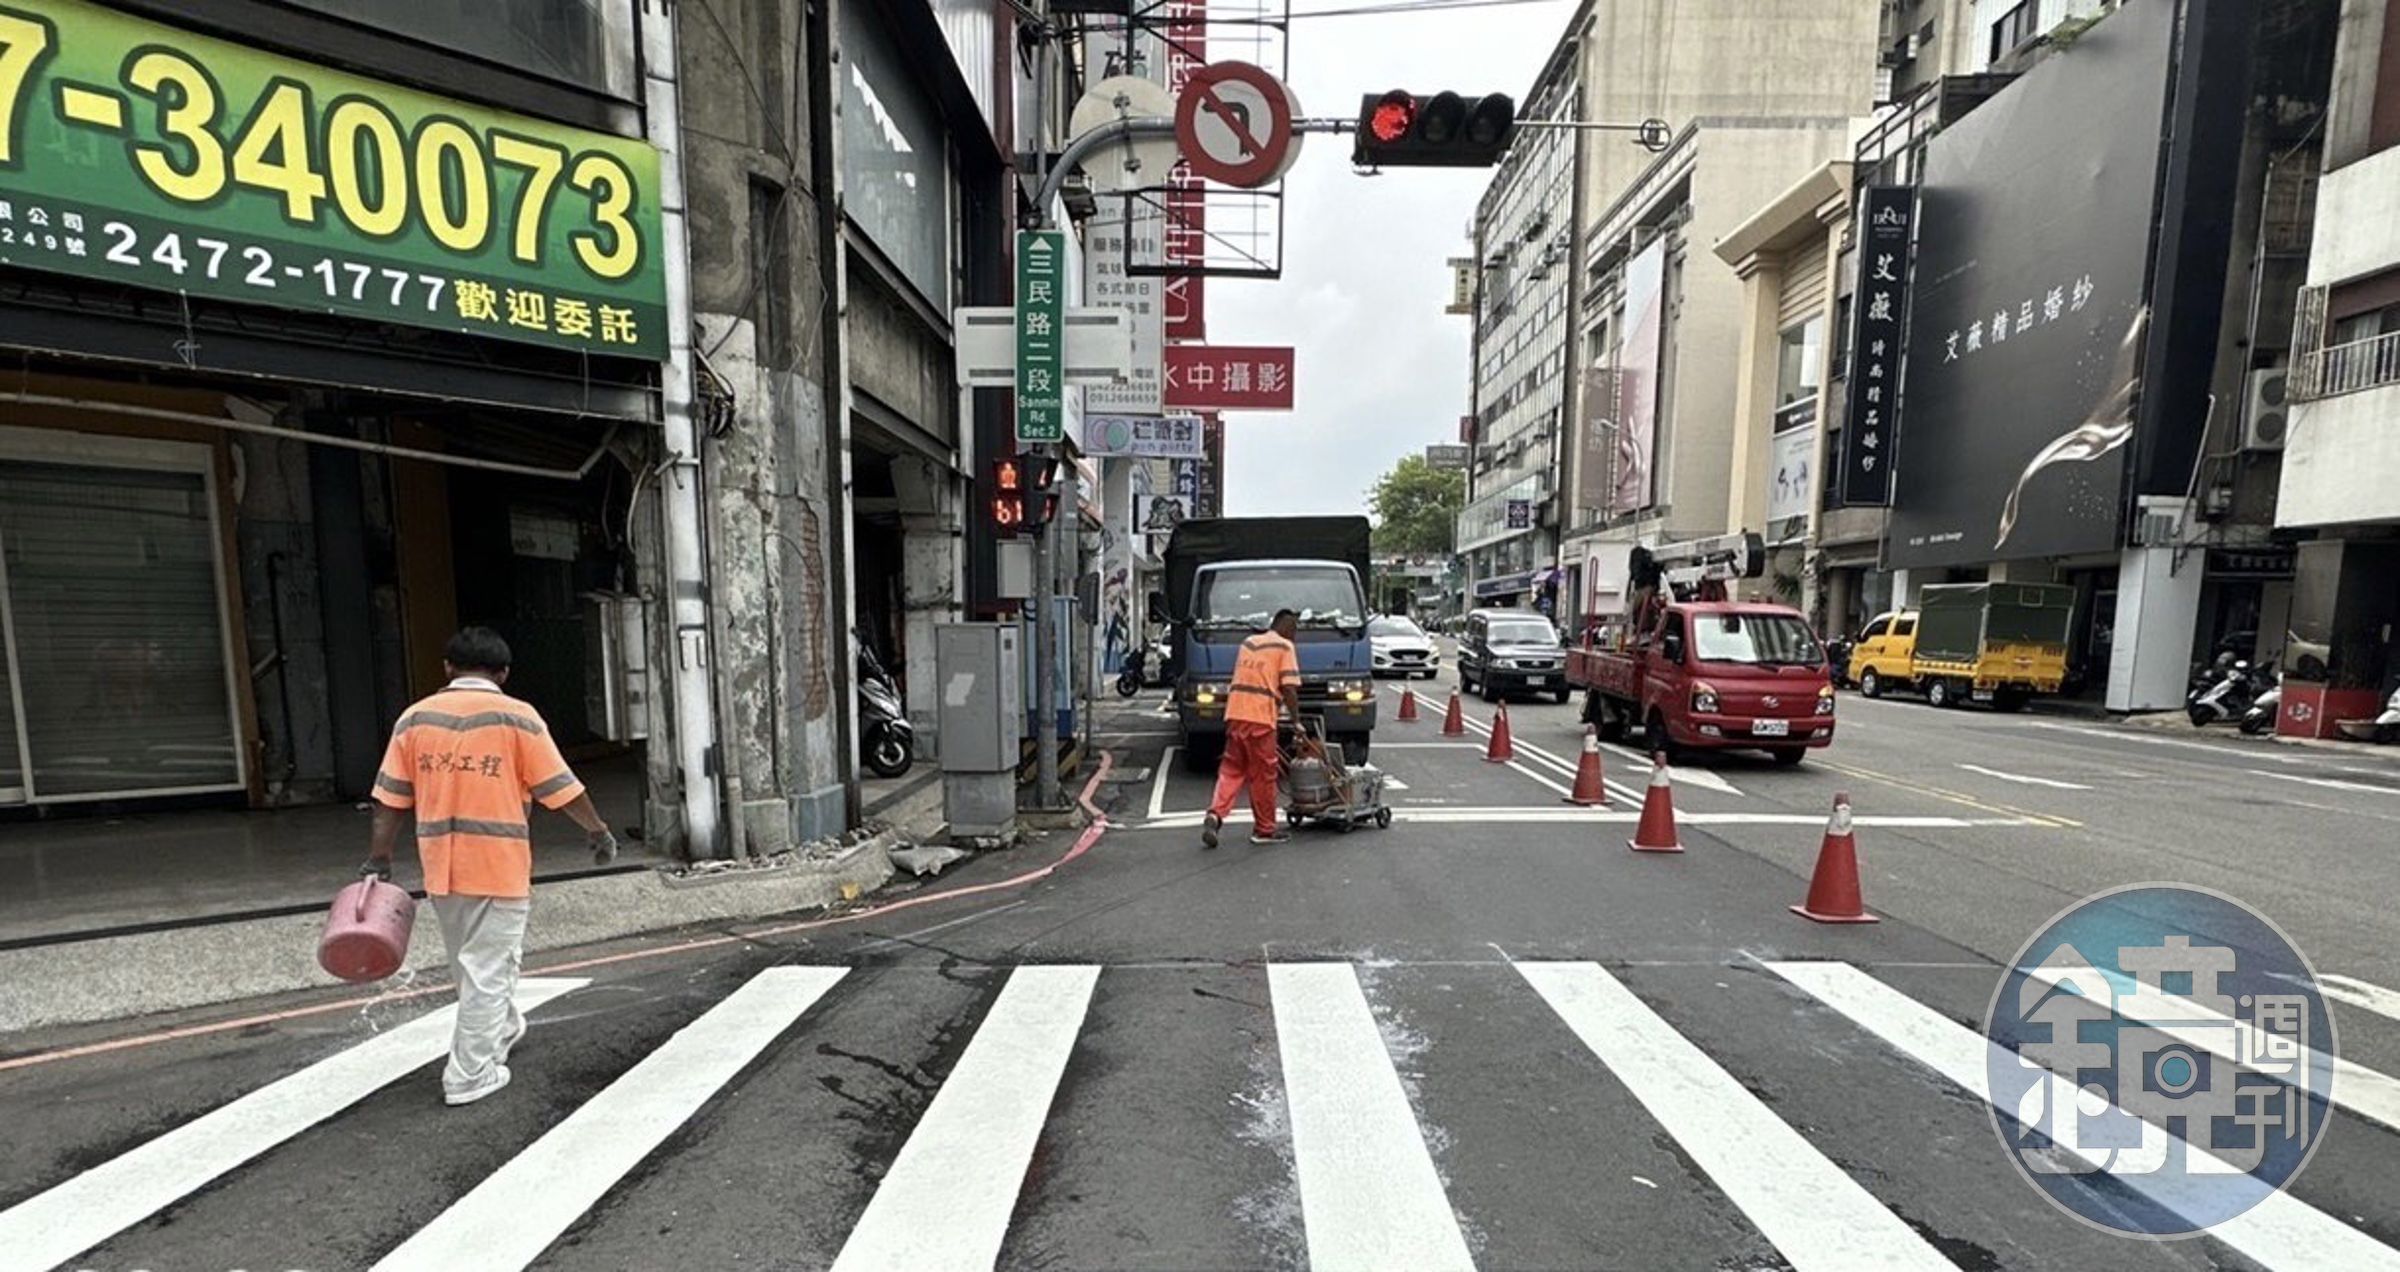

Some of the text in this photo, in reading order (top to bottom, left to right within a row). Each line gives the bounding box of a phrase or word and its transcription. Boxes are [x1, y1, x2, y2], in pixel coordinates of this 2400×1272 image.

[103, 221, 446, 312] 2472-1777
[454, 279, 638, 344] 歡迎委託
[1026, 254, 1054, 392] 三民路二段
[1019, 395, 1061, 408] Sanmin
